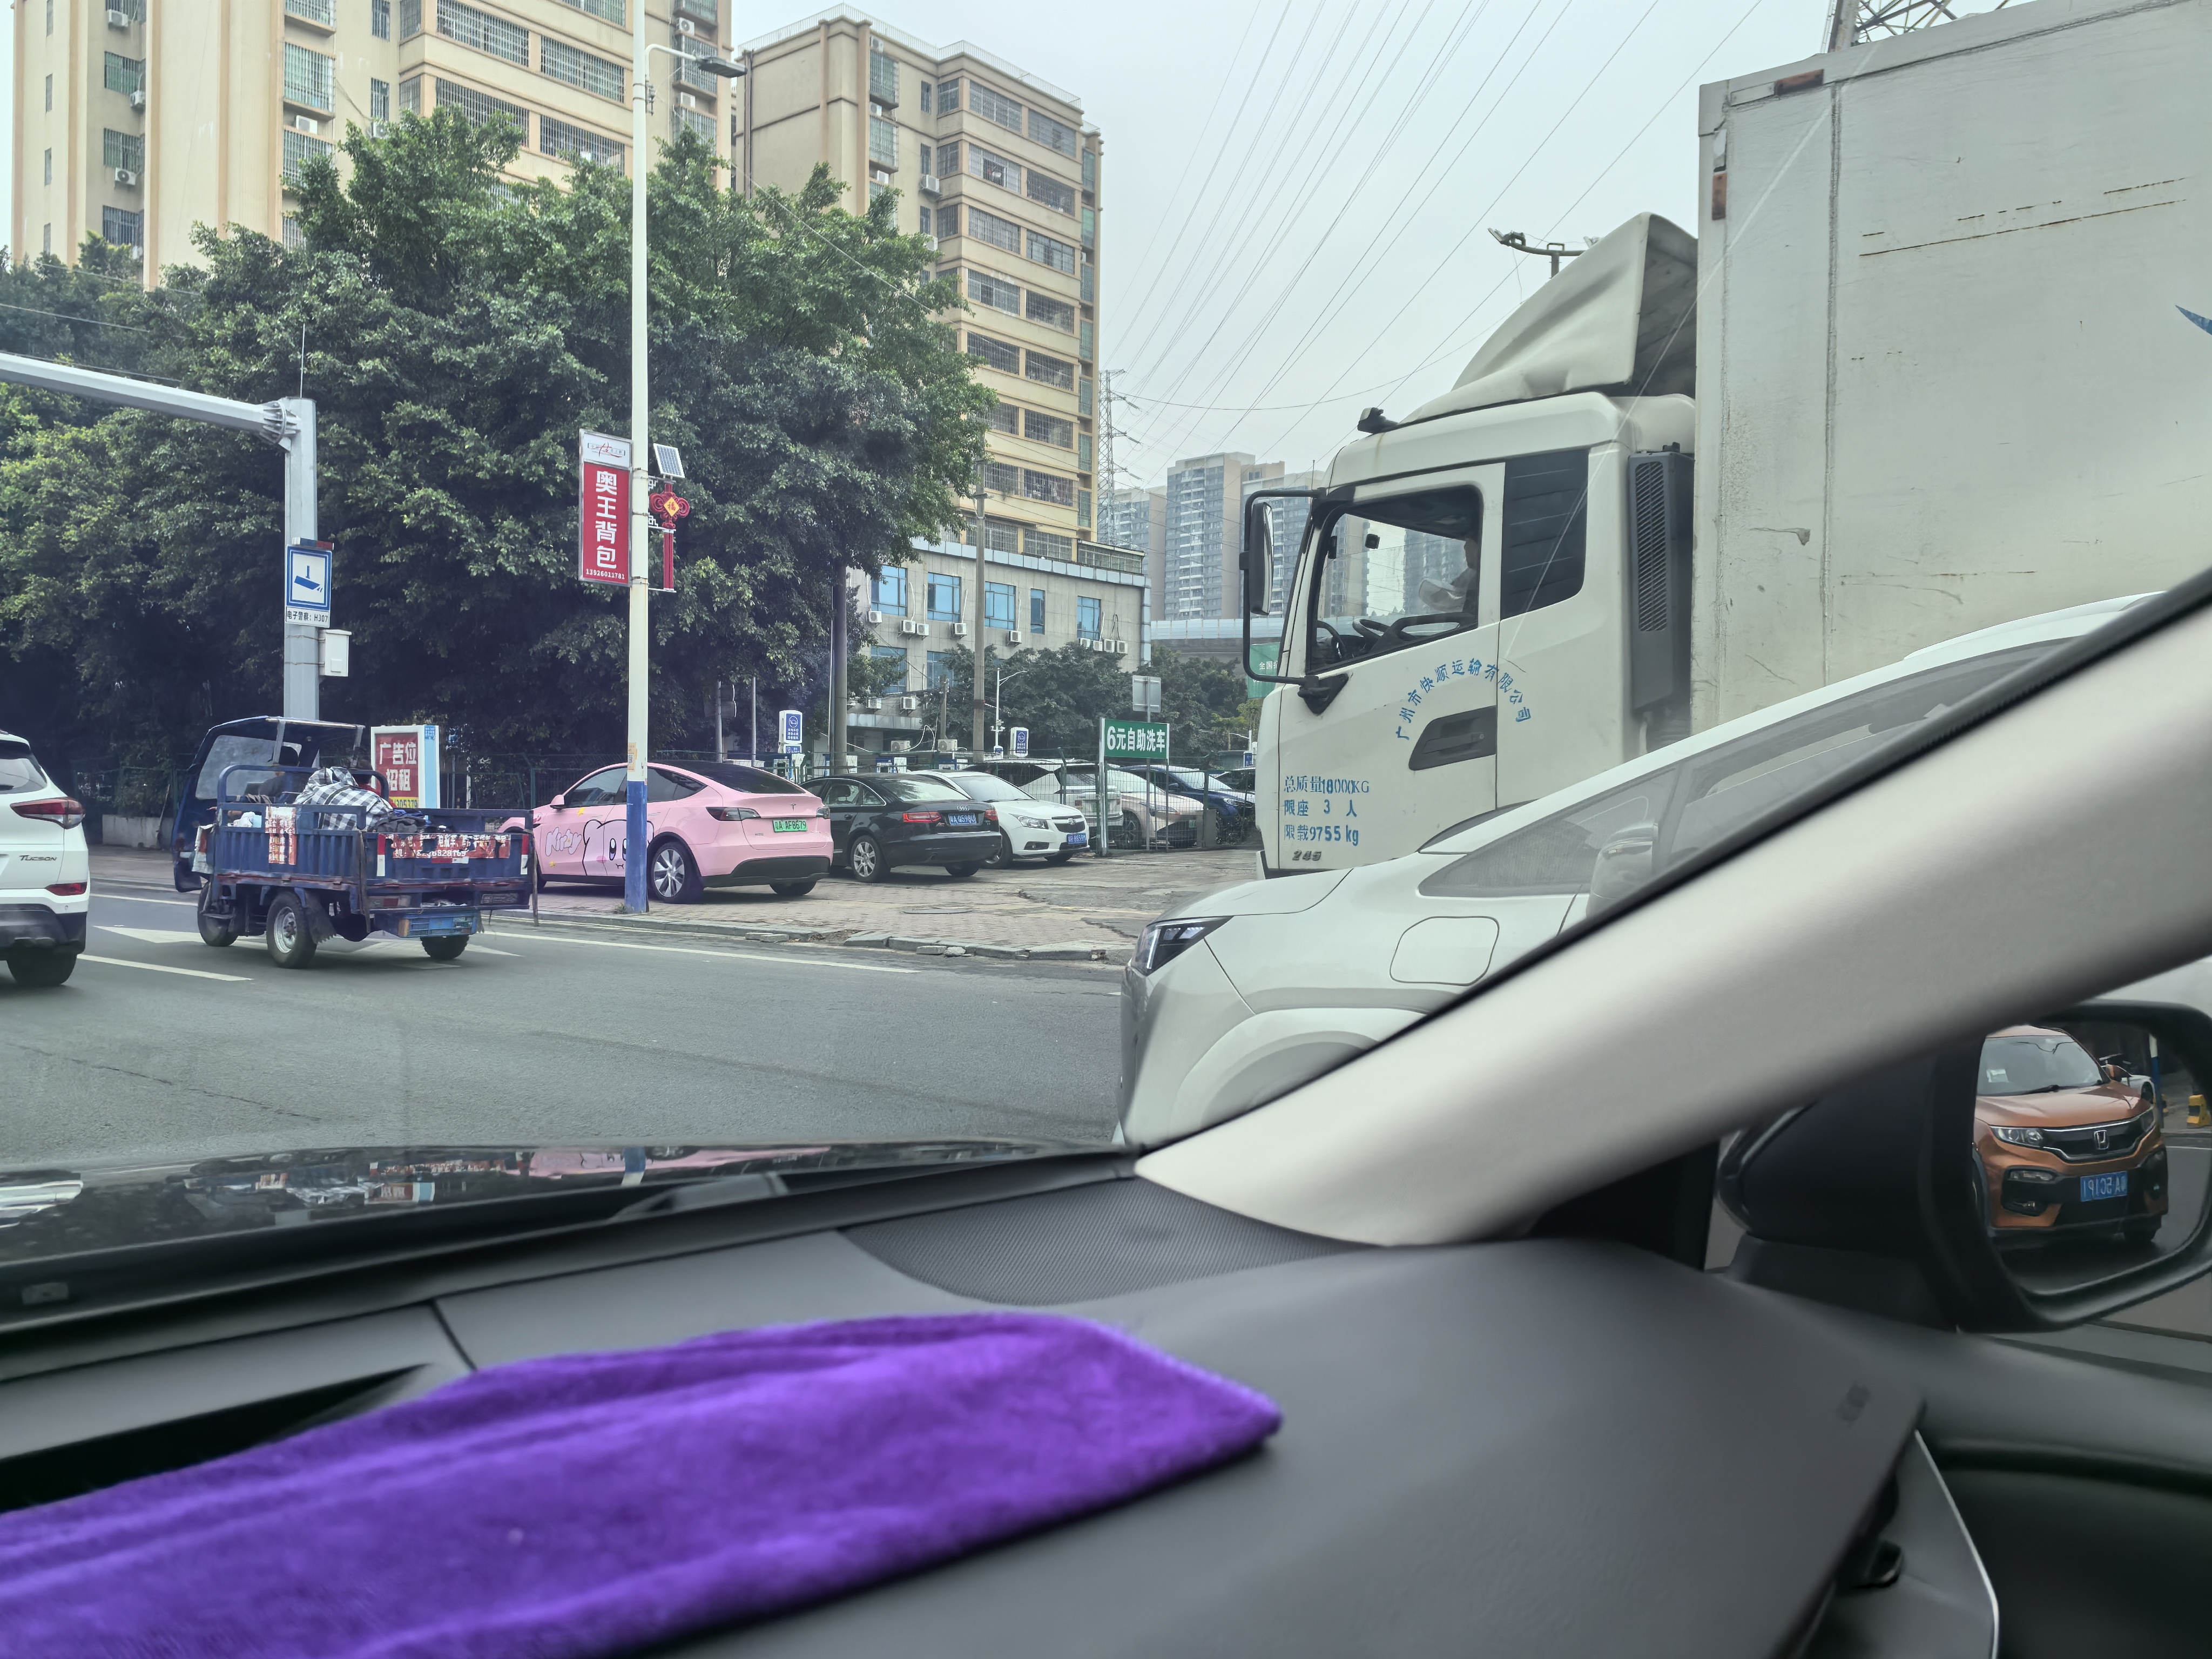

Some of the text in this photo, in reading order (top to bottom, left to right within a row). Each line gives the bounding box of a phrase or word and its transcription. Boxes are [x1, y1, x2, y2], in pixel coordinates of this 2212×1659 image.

[667, 502, 676, 511] 福
[596, 470, 617, 569] 奥王背包
[586, 569, 625, 579] 13926011781
[1395, 658, 1532, 740] 广州市快顺运输有限公司
[1107, 726, 1165, 752] 6元自助洗车
[380, 742, 417, 765] 广告位
[386, 768, 411, 791] 招租
[1284, 799, 1358, 818] 限座 3 人
[545, 827, 582, 857] Kirby
[1292, 849, 1321, 861] 245
